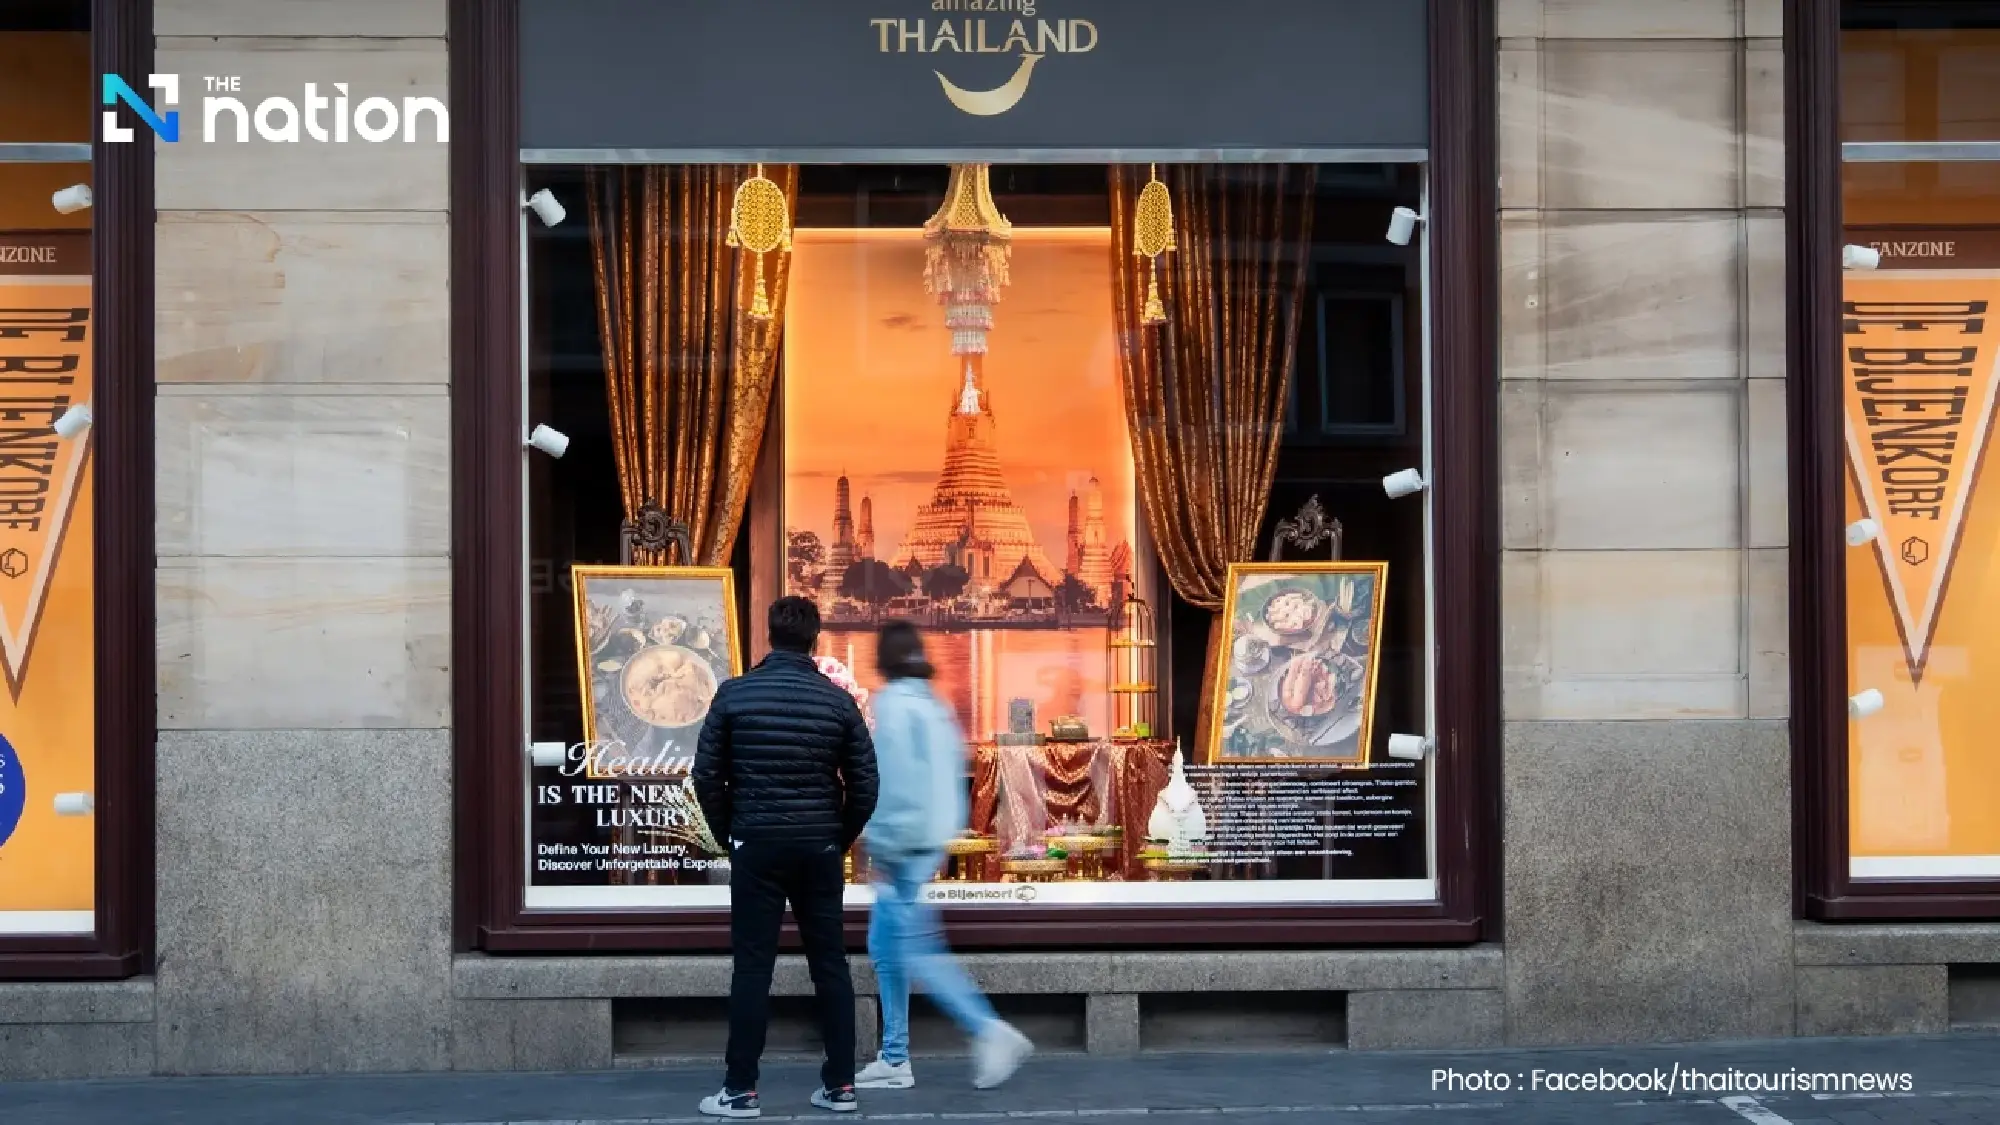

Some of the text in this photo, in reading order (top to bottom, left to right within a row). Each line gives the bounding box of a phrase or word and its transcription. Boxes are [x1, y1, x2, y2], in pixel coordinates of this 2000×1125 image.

[931, 0, 1036, 16] amazing
[870, 19, 1099, 53] THAILAND
[1843, 300, 1988, 520] DE BIJENKORF
[557, 739, 696, 777] Healin
[538, 785, 685, 804] IS THE NEW
[596, 809, 691, 827] LUXURY
[537, 843, 689, 857] Define Your New Luxury.
[537, 858, 592, 871] Discover
[595, 858, 680, 872] Unforgettable
[928, 889, 1013, 901] de Bijenkorf
